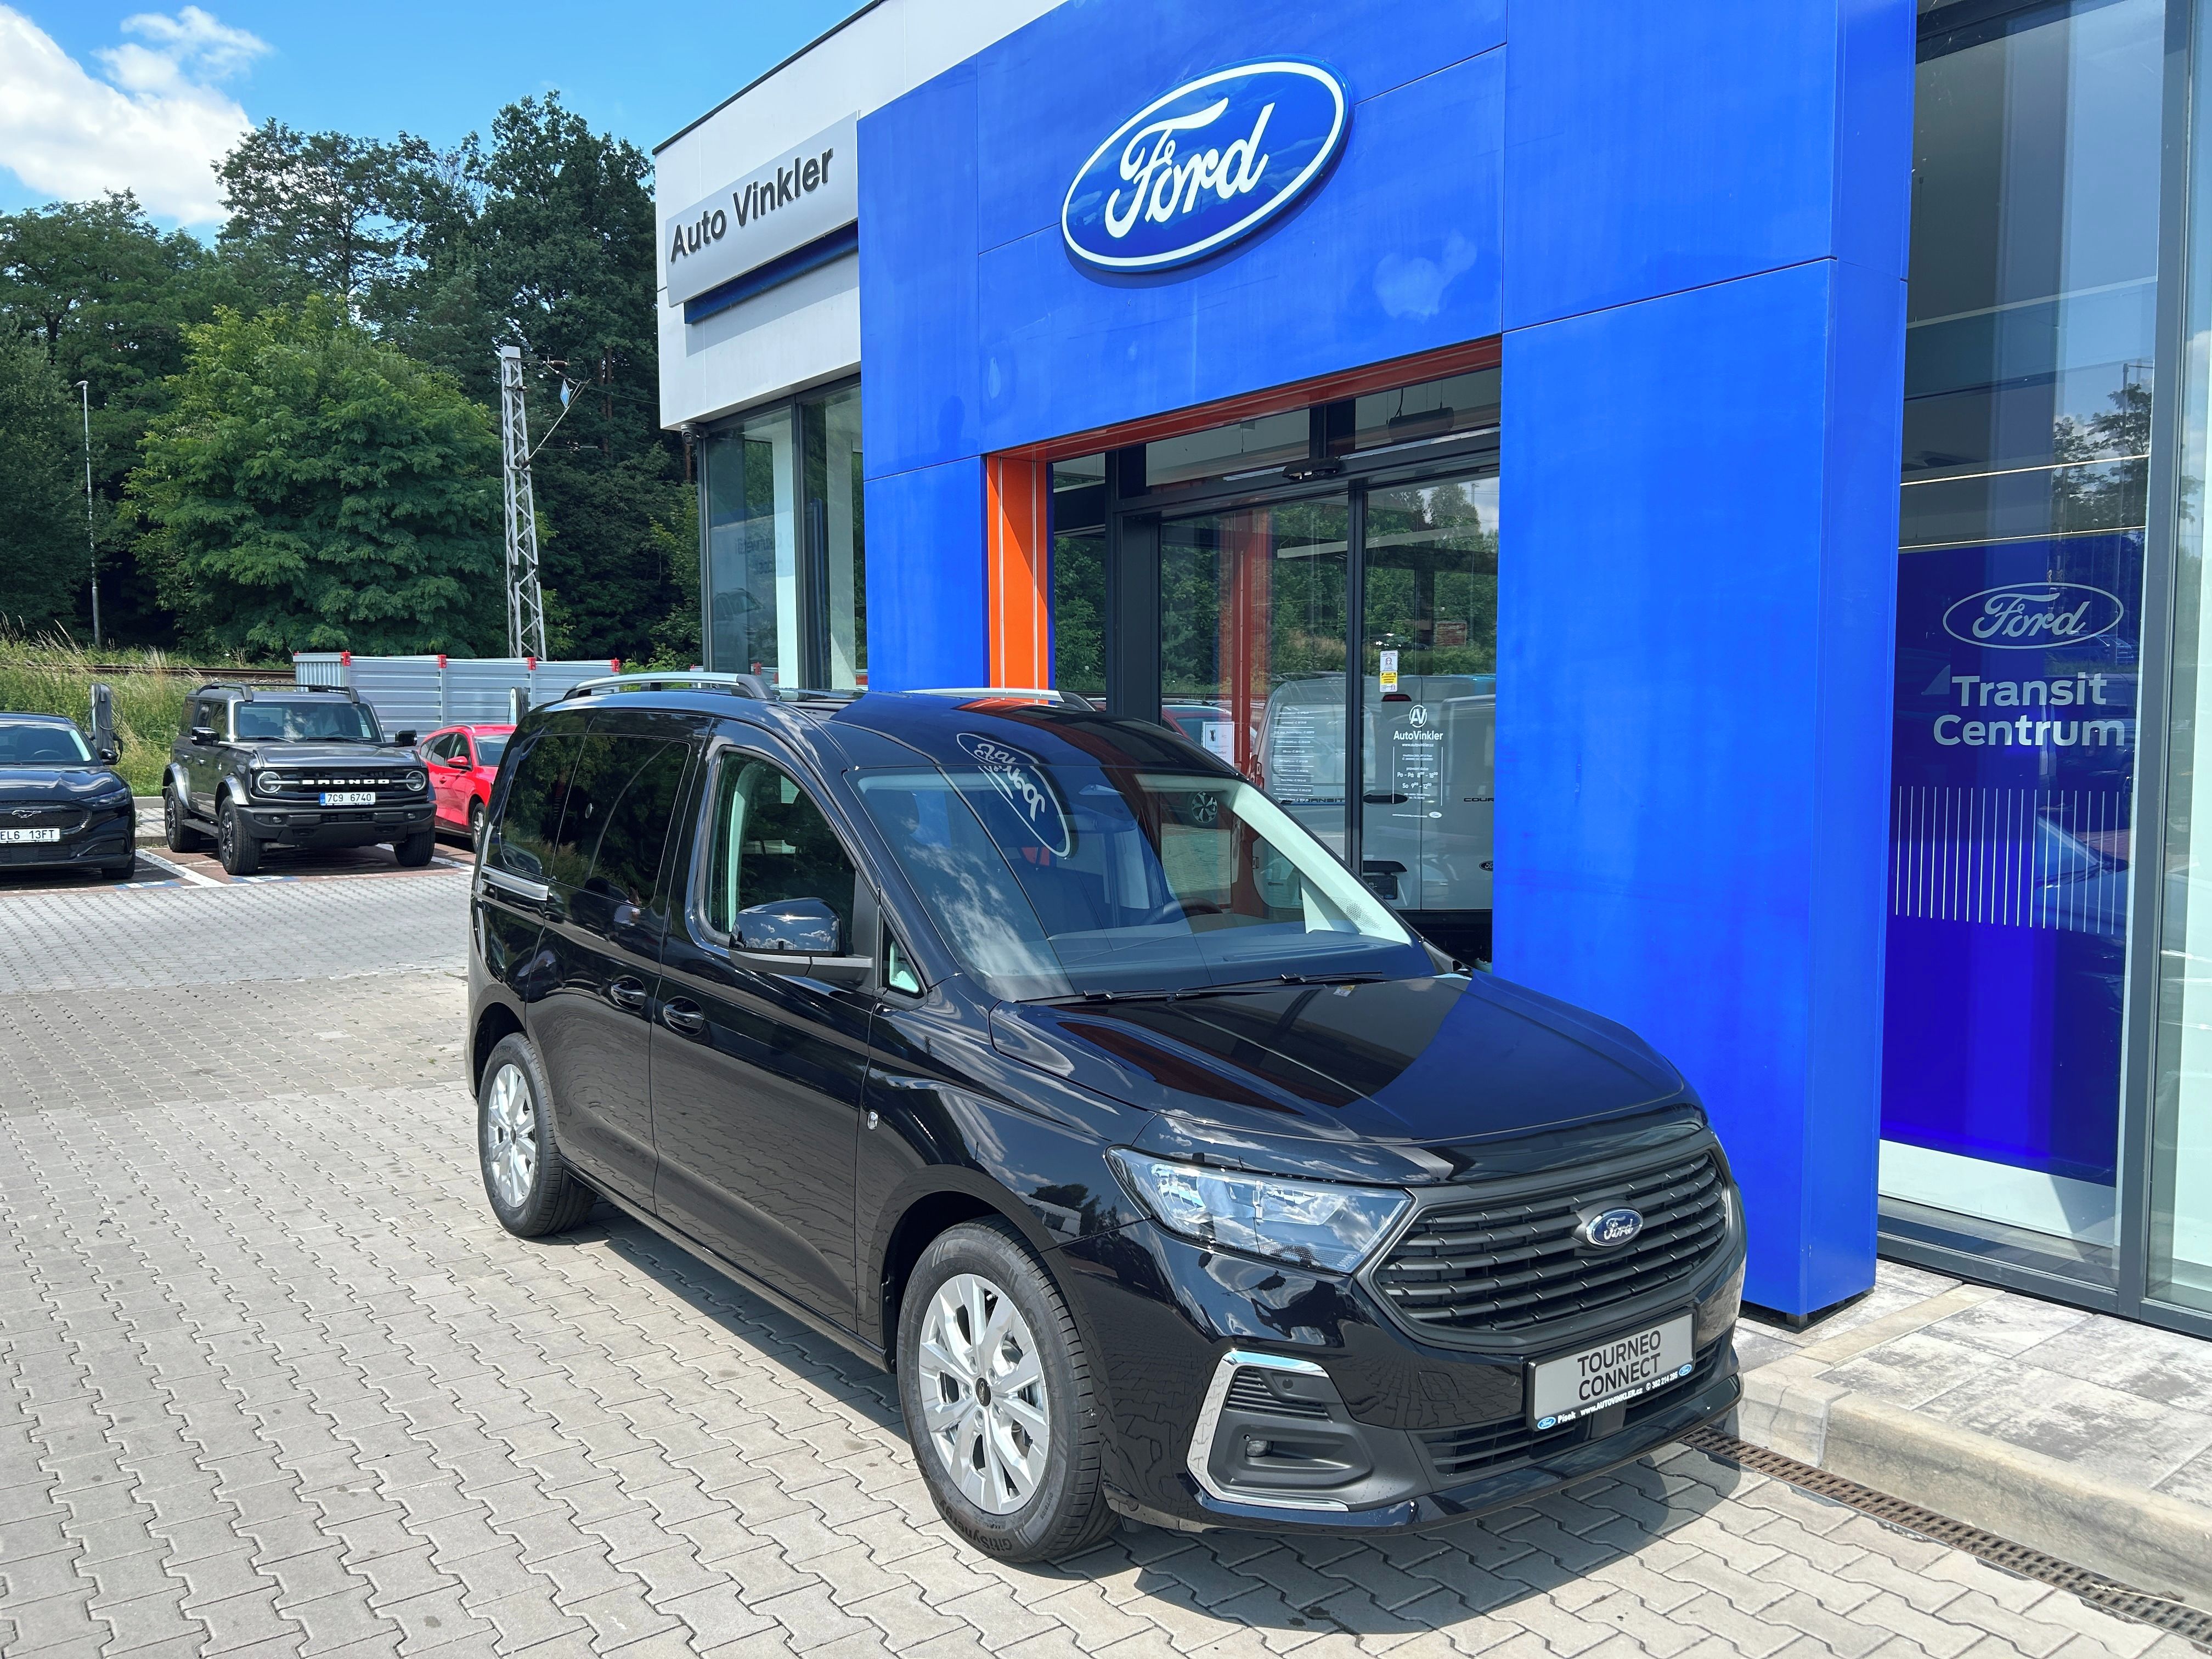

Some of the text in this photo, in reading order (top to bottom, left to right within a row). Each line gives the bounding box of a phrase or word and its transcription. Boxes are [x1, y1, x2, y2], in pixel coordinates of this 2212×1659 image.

[1105, 97, 1276, 238] Ford
[671, 148, 833, 263] Auto Vinkler
[1972, 592, 2091, 639] Ford
[1952, 672, 2107, 707] Transit
[1393, 730, 1443, 740] AutoVinkler
[1933, 715, 2125, 746] Centrum
[328, 793, 371, 802] 7C9 6740
[0, 830, 55, 840] EL6 13FT
[1604, 1216, 1633, 1240] Ford
[1577, 1330, 1661, 1376] TOURNEO
[1579, 1352, 1661, 1401] CONNECT
